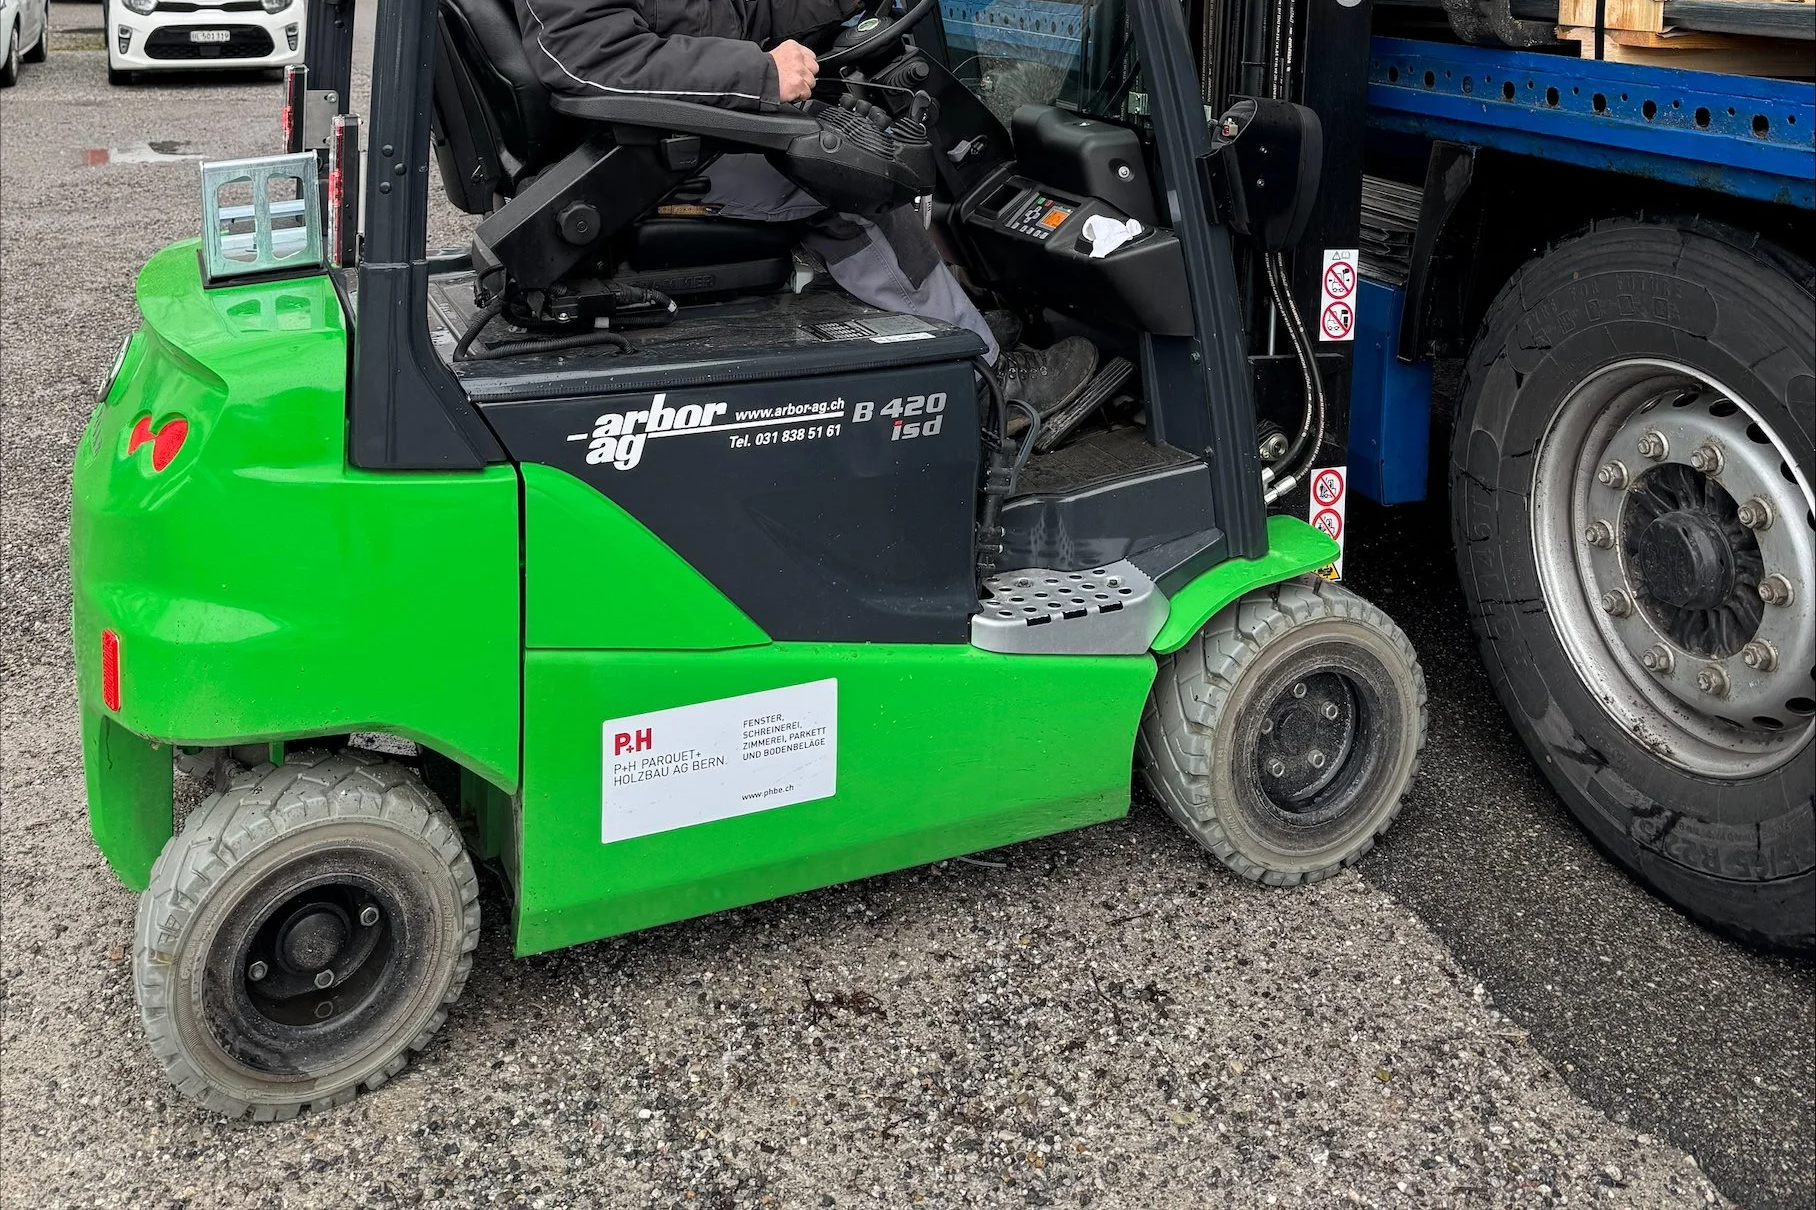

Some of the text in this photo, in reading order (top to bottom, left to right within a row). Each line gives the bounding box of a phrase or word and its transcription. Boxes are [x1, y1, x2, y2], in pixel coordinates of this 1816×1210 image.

[592, 393, 728, 439] arbor
[735, 396, 845, 421] www.arbor-ag.ch
[852, 392, 948, 424] B 420
[729, 423, 843, 449] Tel. 031 838 51 61
[891, 414, 943, 441] isd
[585, 430, 649, 471] ag
[742, 721, 803, 739] SCHREINEREI,
[743, 713, 785, 728] FENSTER,
[614, 727, 652, 756] P+H
[742, 727, 826, 750] ZIMMEREI, PARKETT
[742, 737, 826, 761] UND BODENBELÄGE
[613, 749, 702, 775] P+H PARQUET+
[614, 767, 670, 786] HOLZBAU
[672, 764, 689, 775] AG
[741, 784, 794, 801] www.phbe.ch
